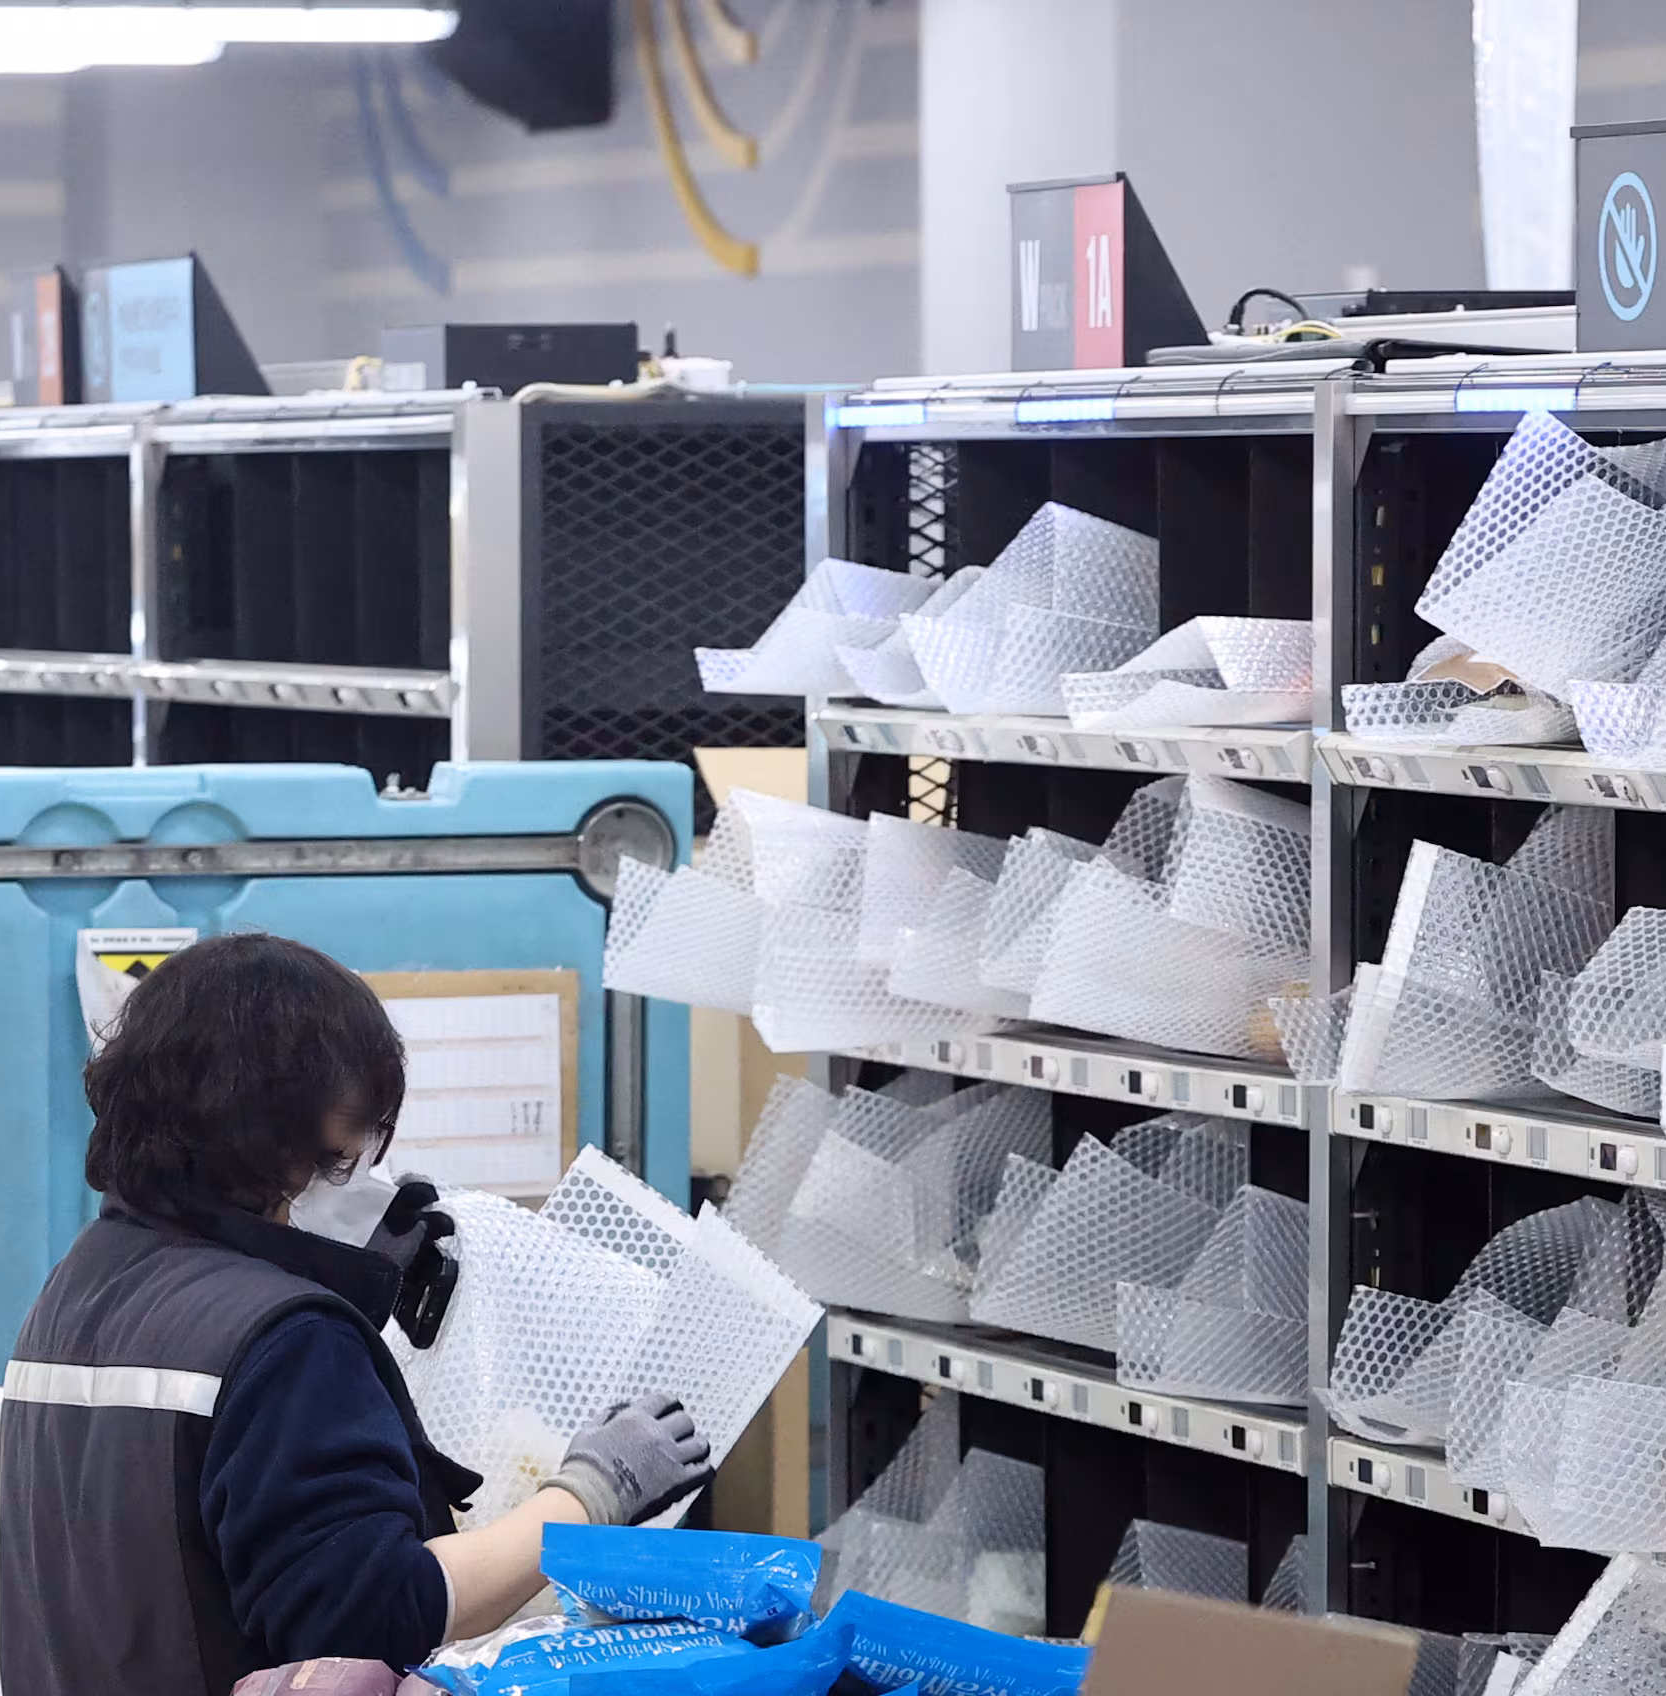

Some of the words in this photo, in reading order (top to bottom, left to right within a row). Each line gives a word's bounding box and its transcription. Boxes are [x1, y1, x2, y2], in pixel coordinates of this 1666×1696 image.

[1085, 233, 1112, 329] 1A
[577, 1579, 617, 1599] Raw
[626, 1585, 702, 1613] Shrimp
